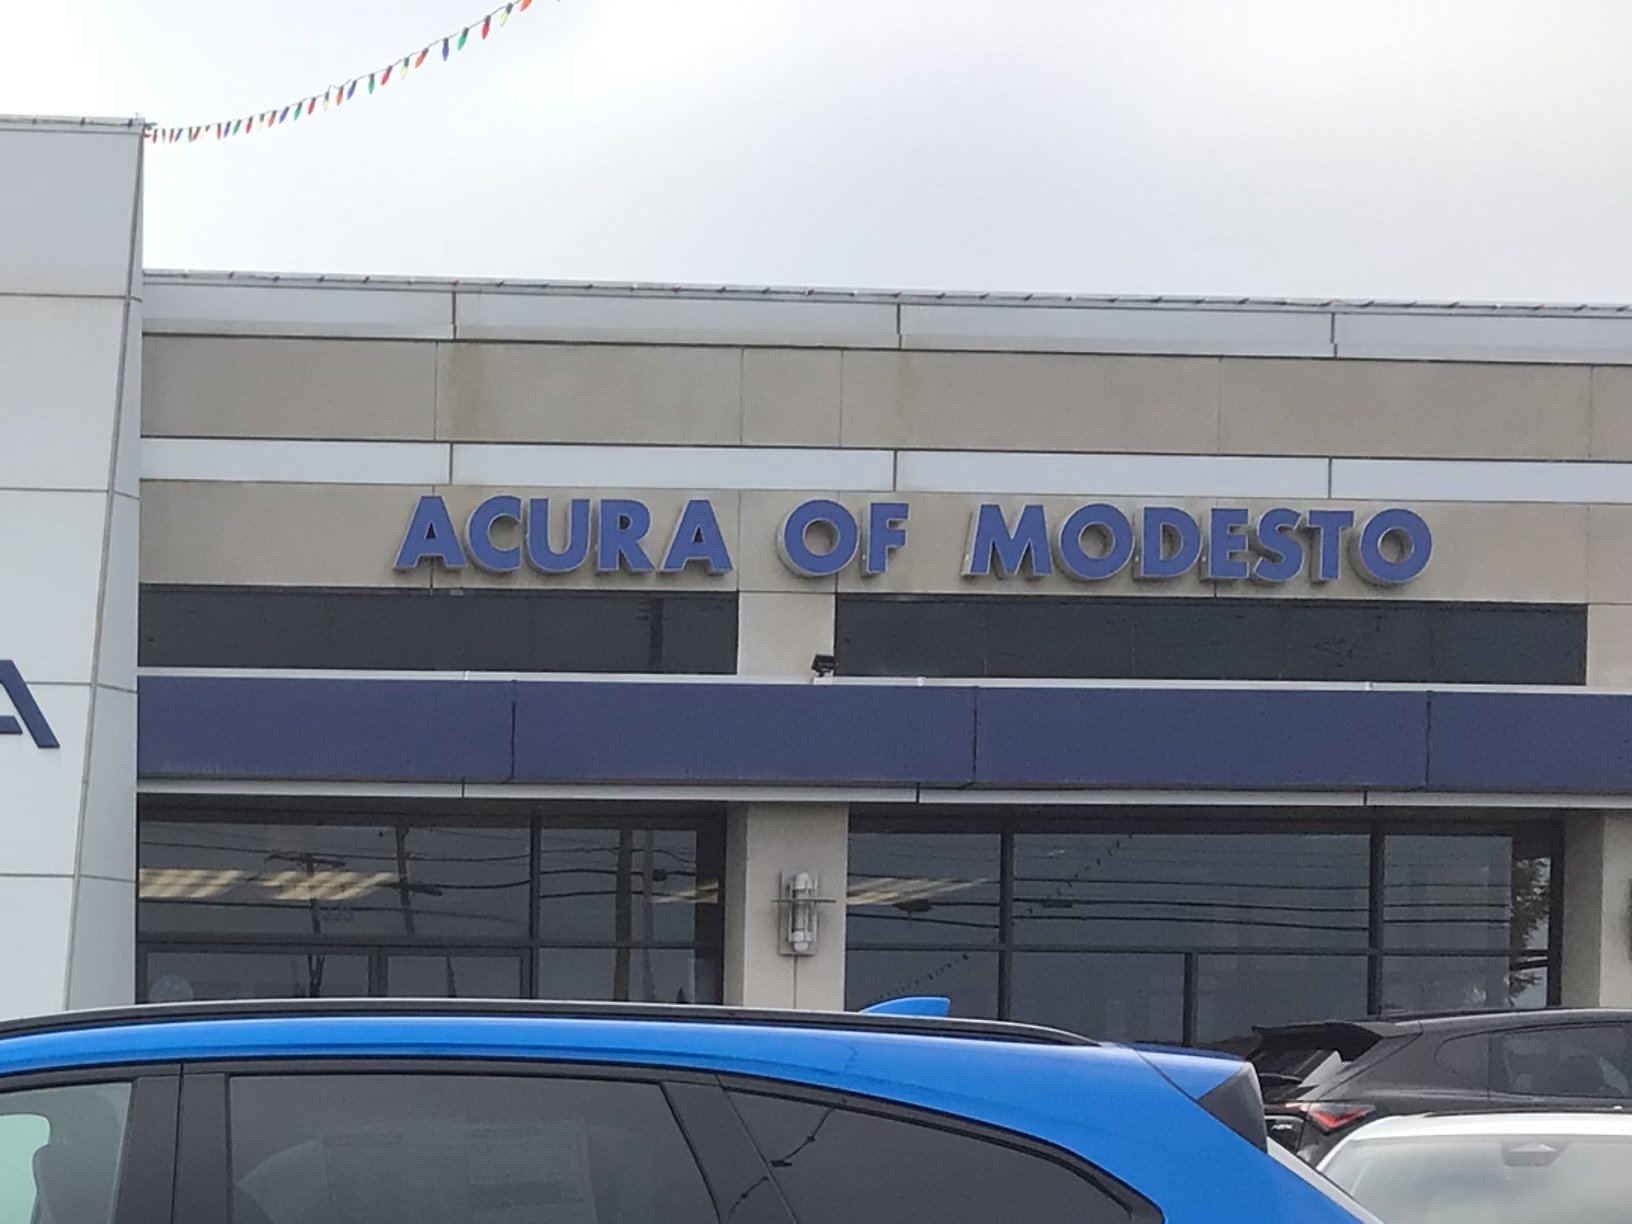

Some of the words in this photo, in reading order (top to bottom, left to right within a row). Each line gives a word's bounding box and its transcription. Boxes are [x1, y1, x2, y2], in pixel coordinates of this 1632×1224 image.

[393, 495, 735, 576] ACURA
[779, 499, 909, 578] OF
[963, 502, 1433, 584] MODESTO
